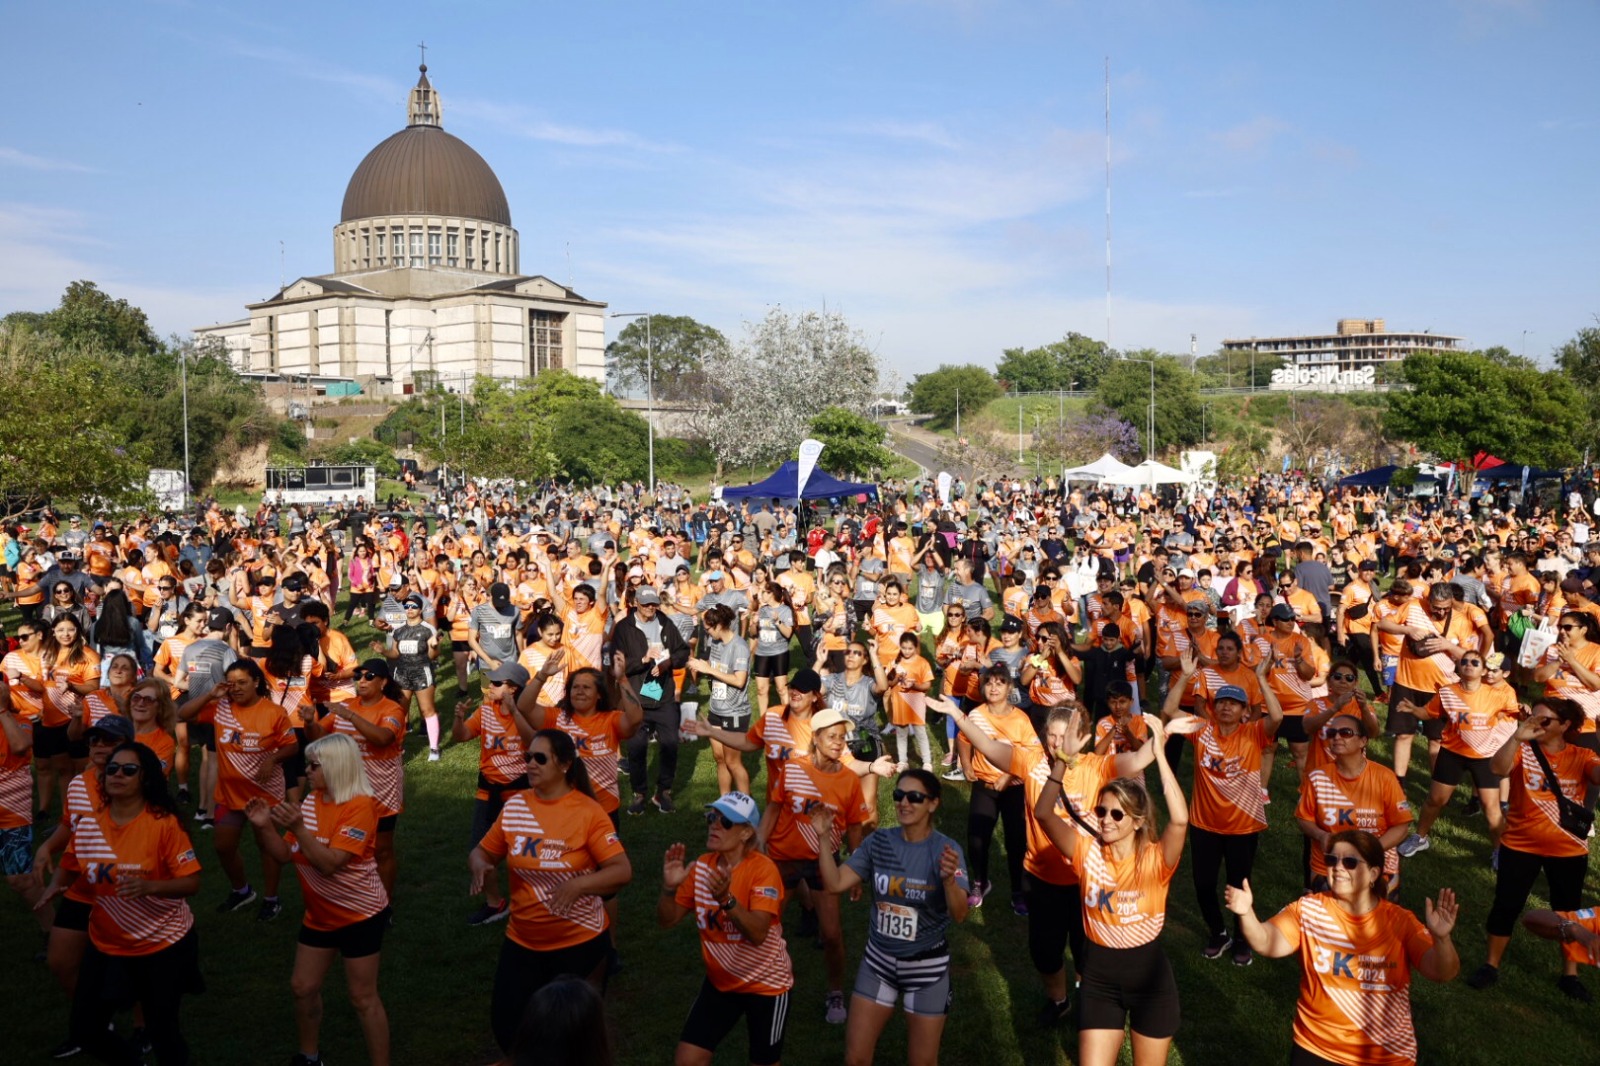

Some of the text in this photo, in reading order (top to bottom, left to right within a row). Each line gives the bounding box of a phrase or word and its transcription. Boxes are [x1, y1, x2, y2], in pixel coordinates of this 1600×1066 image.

[220, 728, 242, 745] 3K
[485, 733, 505, 750] 3K
[769, 744, 793, 760] 3K
[1323, 808, 1355, 827] 3K
[1356, 817, 1377, 828] 2024
[511, 835, 542, 858] 3K
[539, 848, 562, 860] 2024
[87, 862, 116, 884] 3K
[874, 872, 906, 898] 10K
[905, 888, 926, 900] 2024
[1085, 882, 1115, 914] 3K
[697, 906, 722, 931] 3K
[879, 911, 913, 939] 1135
[1313, 945, 1355, 979] 3K
[1357, 968, 1386, 982] 2024
